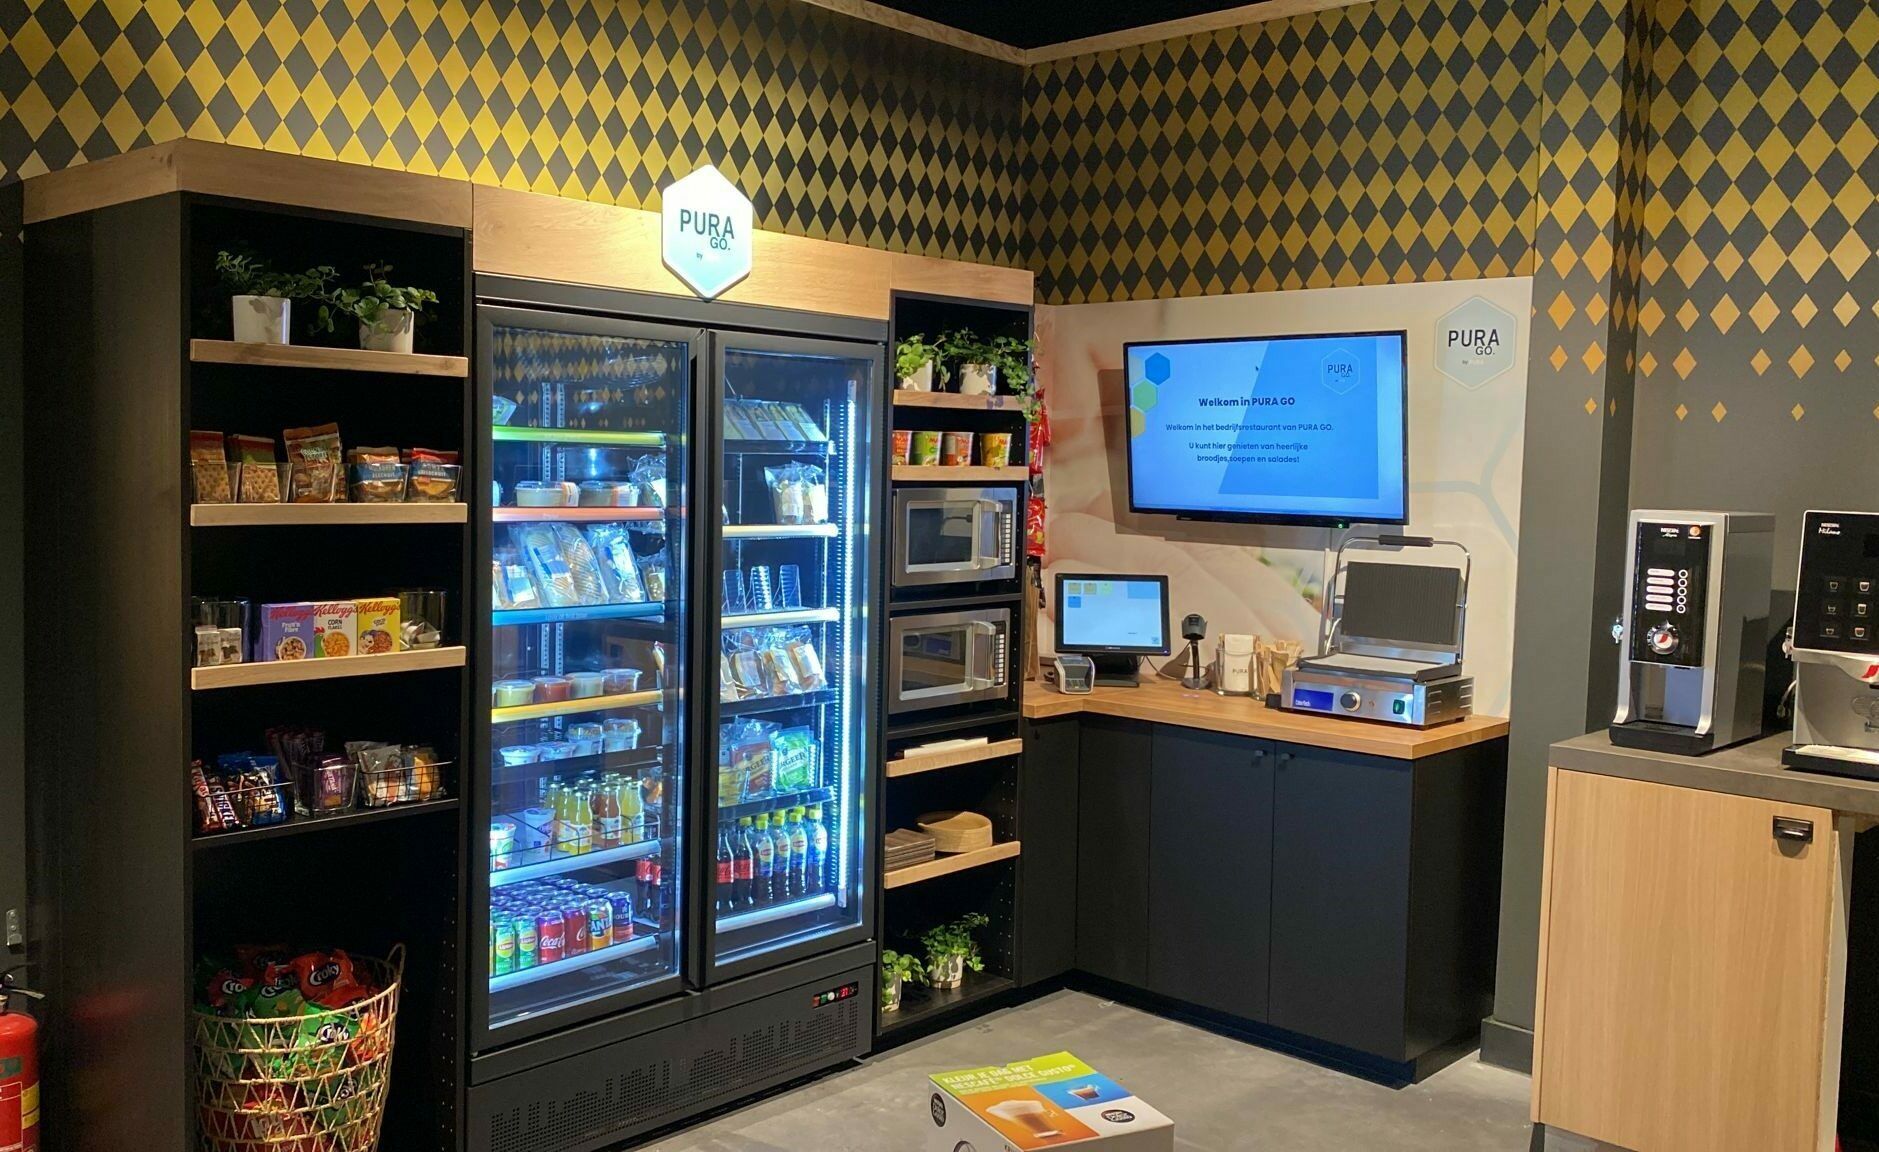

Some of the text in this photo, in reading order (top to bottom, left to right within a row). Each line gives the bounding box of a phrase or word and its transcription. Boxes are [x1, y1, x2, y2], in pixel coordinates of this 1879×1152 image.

[680, 208, 735, 240] PURA
[709, 236, 731, 251] GO.
[1448, 329, 1500, 347] PURA
[1475, 345, 1495, 356] GO.
[1327, 363, 1353, 373] PURA
[1199, 397, 1296, 407] Welkom in PURA GO
[1165, 423, 1194, 431] Welkom
[1194, 423, 1202, 431] in
[1202, 423, 1215, 431] het
[1215, 423, 1281, 433] bedrijfsrestaurant
[1298, 423, 1318, 431] PURA
[1320, 423, 1334, 431] GO.
[1227, 442, 1259, 451] genieten
[1276, 442, 1308, 452] heerlijke
[314, 604, 358, 618] Kellogg's
[310, 963, 340, 986] Croky
